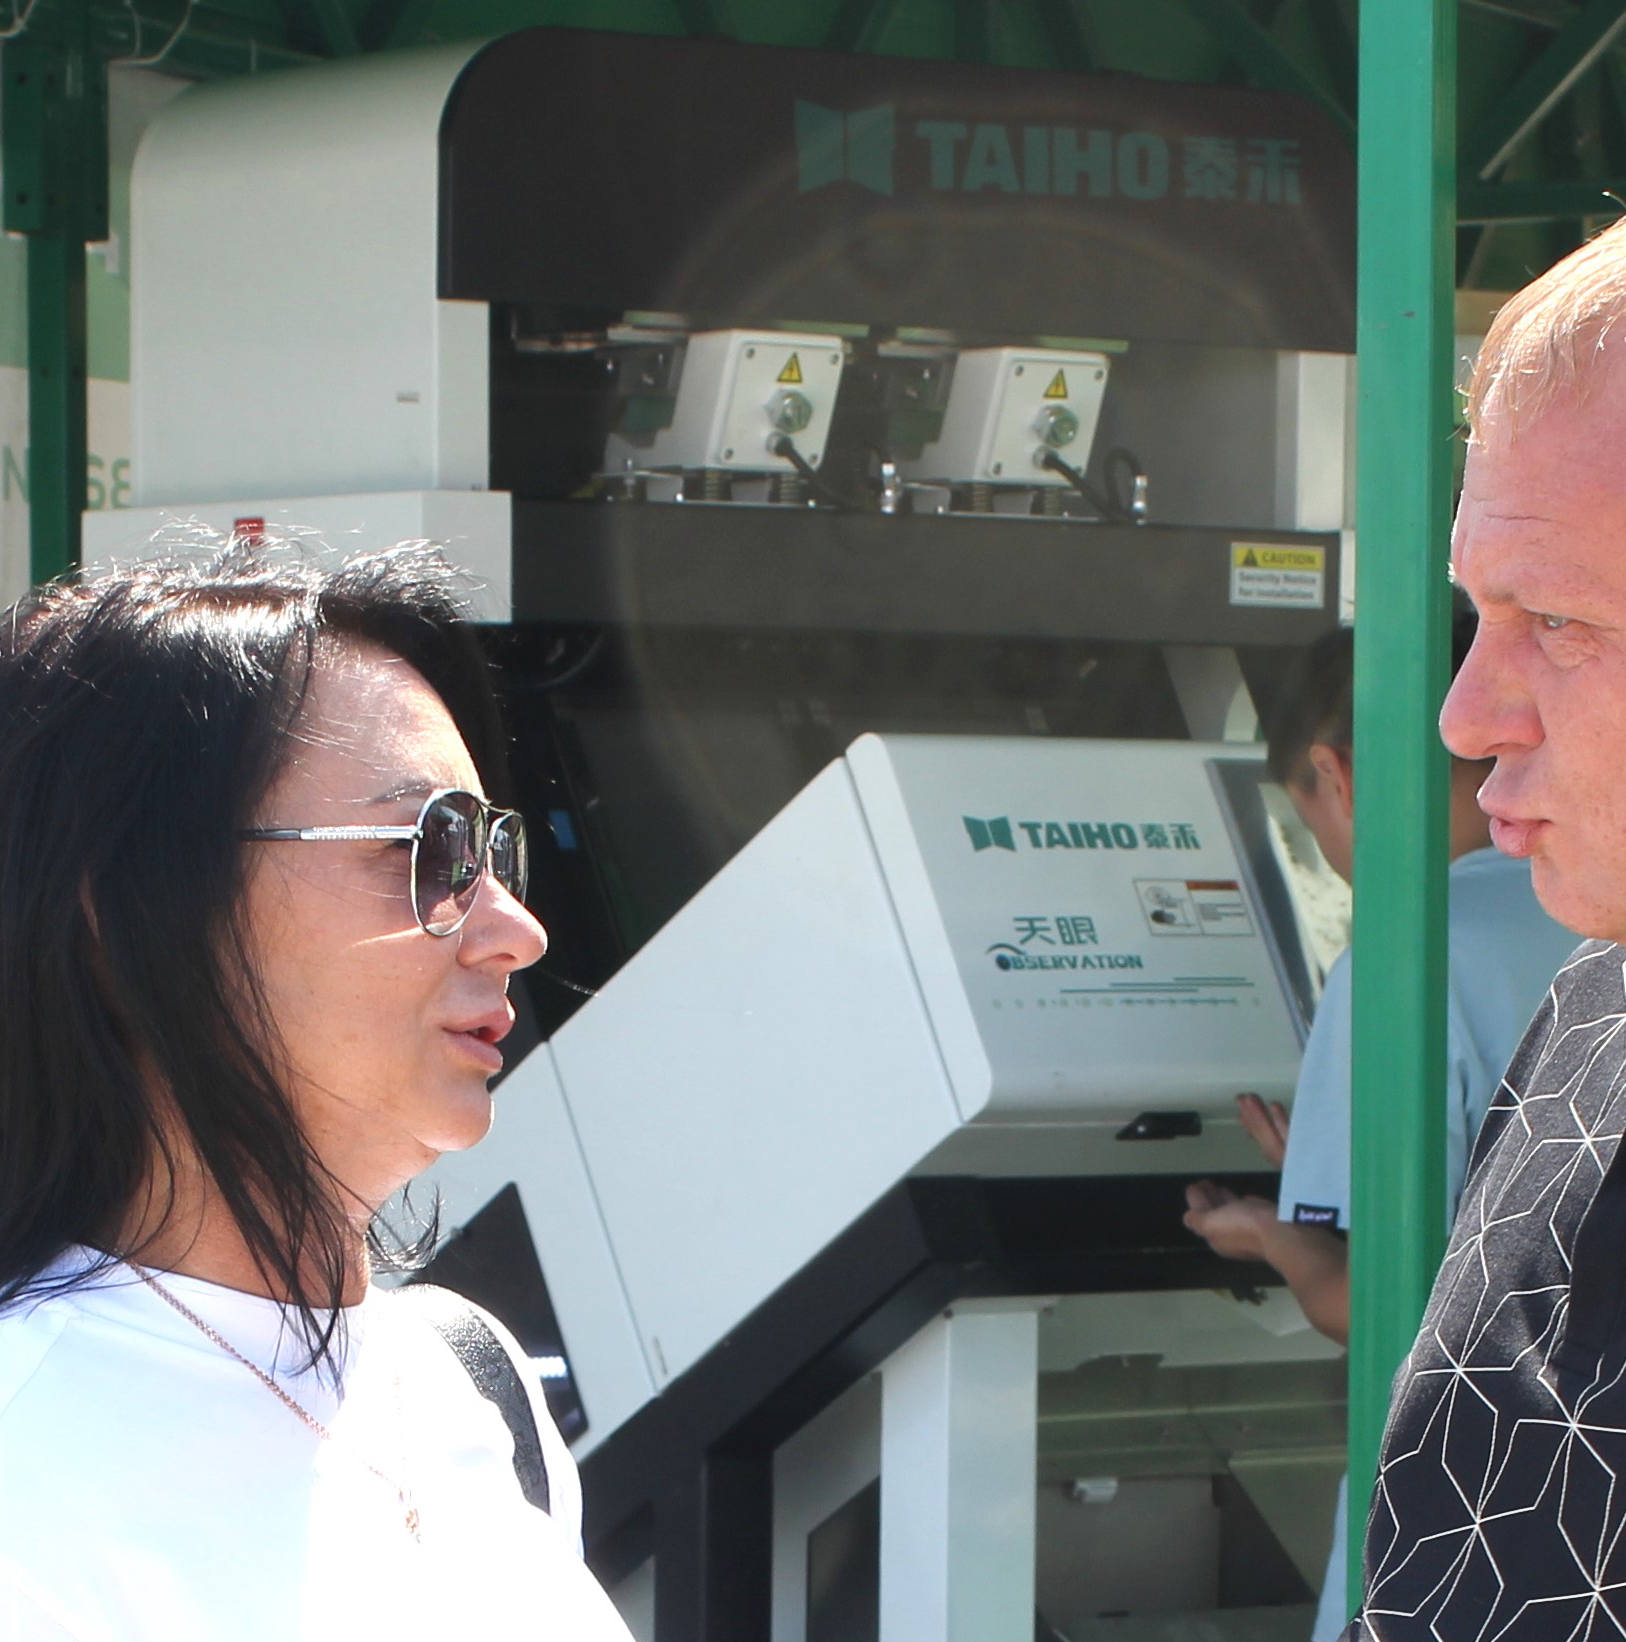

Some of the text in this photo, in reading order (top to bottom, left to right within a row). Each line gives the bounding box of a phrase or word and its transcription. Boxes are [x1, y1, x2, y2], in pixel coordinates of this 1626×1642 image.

[916, 119, 1171, 199] TAIHO
[1018, 821, 1140, 850] TAIHO
[1013, 915, 1100, 945] 天眼
